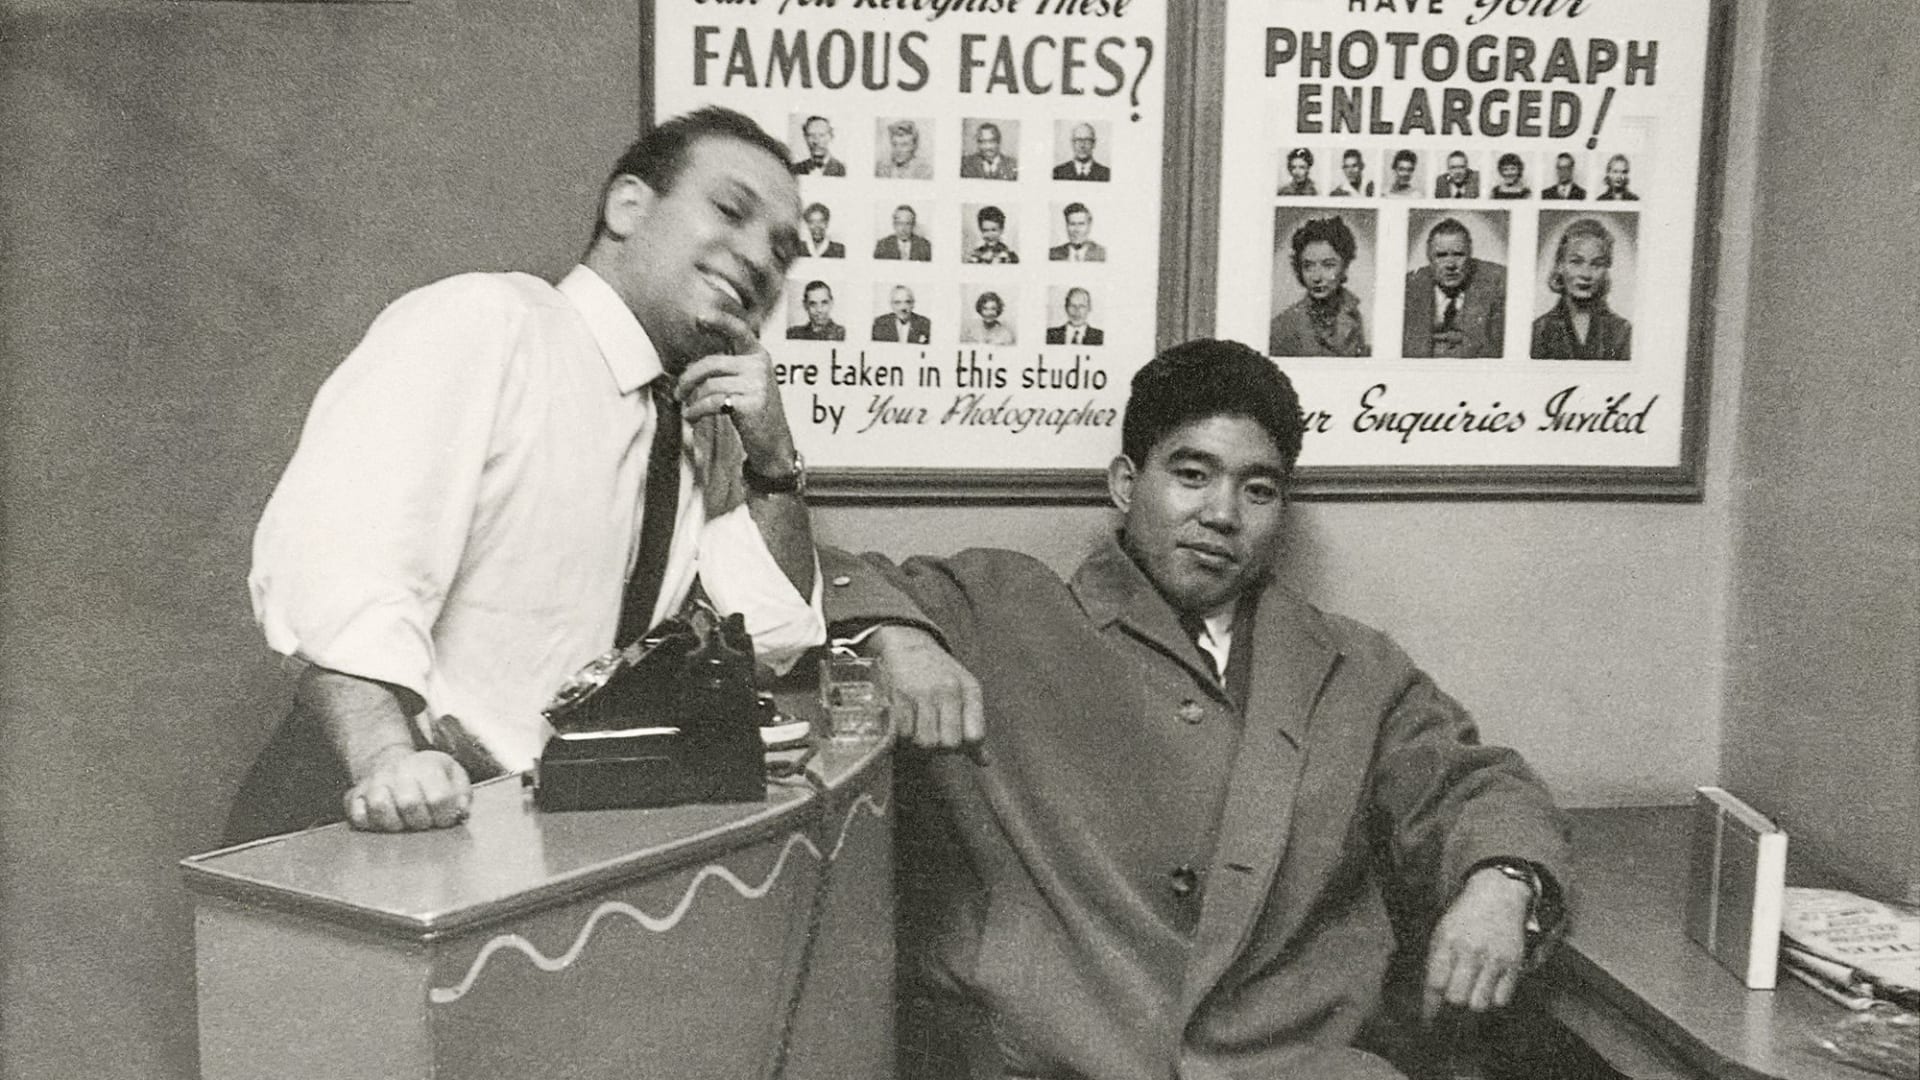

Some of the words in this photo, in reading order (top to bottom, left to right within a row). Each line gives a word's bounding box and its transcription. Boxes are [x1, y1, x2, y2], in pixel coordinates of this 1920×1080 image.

[693, 25, 930, 92] FAMOUS
[959, 34, 1154, 123] FACES?
[1265, 26, 1659, 86] PHOTOGRAPH
[1297, 83, 1617, 150] ENLARGED!
[775, 363, 819, 386] ere
[830, 348, 904, 388] taken
[919, 351, 941, 388] in
[956, 349, 1008, 389] this
[1021, 354, 1108, 390] studio
[812, 393, 846, 434] by
[857, 394, 928, 434] Your
[940, 392, 1118, 434] Photographer
[1353, 383, 1527, 444] Enquiries
[1537, 384, 1660, 434] Invited
